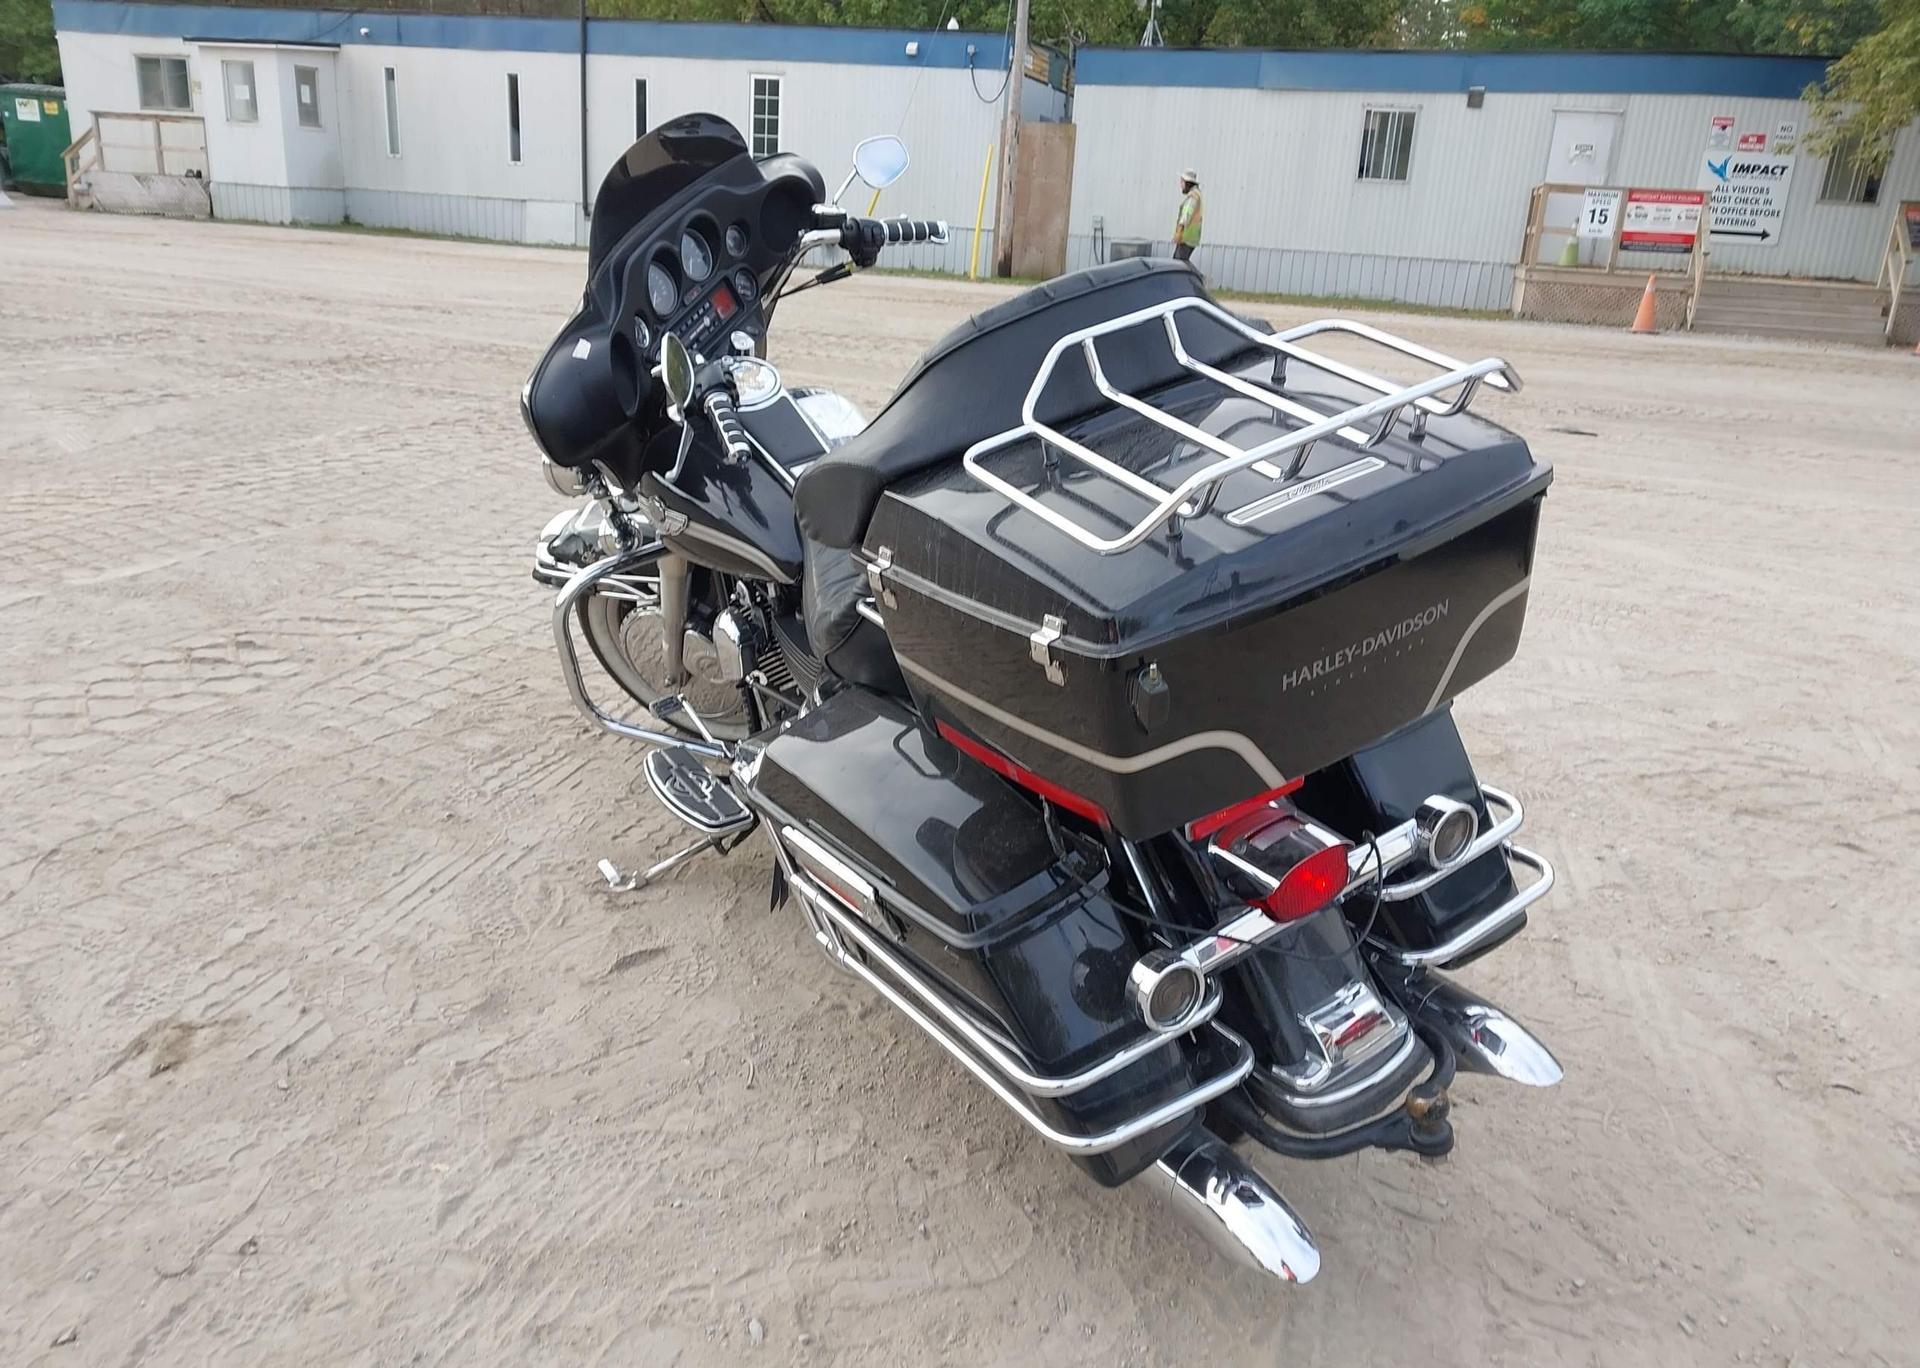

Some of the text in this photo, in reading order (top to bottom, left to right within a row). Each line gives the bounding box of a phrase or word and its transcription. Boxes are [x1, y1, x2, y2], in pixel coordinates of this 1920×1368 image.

[1780, 124, 1792, 132] NO
[1732, 163, 1788, 176] IMPACT
[1588, 191, 1619, 199] MAXIMUM
[1715, 184, 1770, 196] ALL VISITORS
[1734, 196, 1761, 206] CHECK
[1763, 197, 1774, 206] IN
[1589, 208, 1609, 225] 15
[1720, 206, 1747, 216] OFFICE
[1749, 208, 1781, 218] BEFORE
[1714, 216, 1757, 227] ENTERING
[1281, 598, 1450, 693] HARLEY-DAVIDSON
